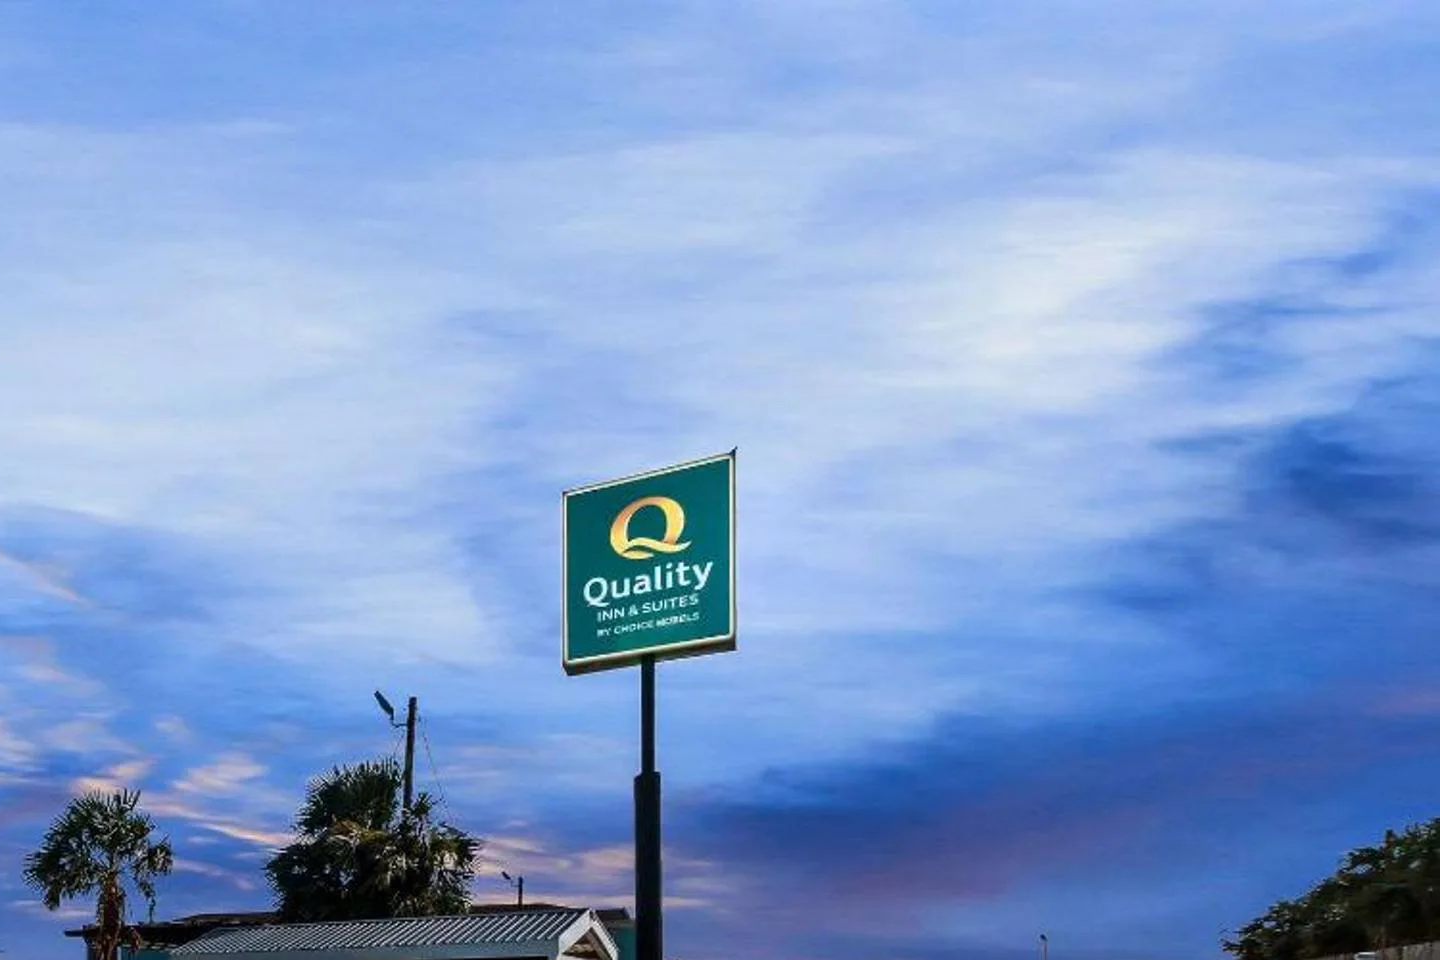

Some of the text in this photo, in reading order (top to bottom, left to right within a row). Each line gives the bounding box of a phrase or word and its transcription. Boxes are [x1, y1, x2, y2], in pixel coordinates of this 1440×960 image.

[610, 496, 692, 560] Q
[583, 561, 714, 607] Quality
[597, 593, 699, 622] INN & SUITES
